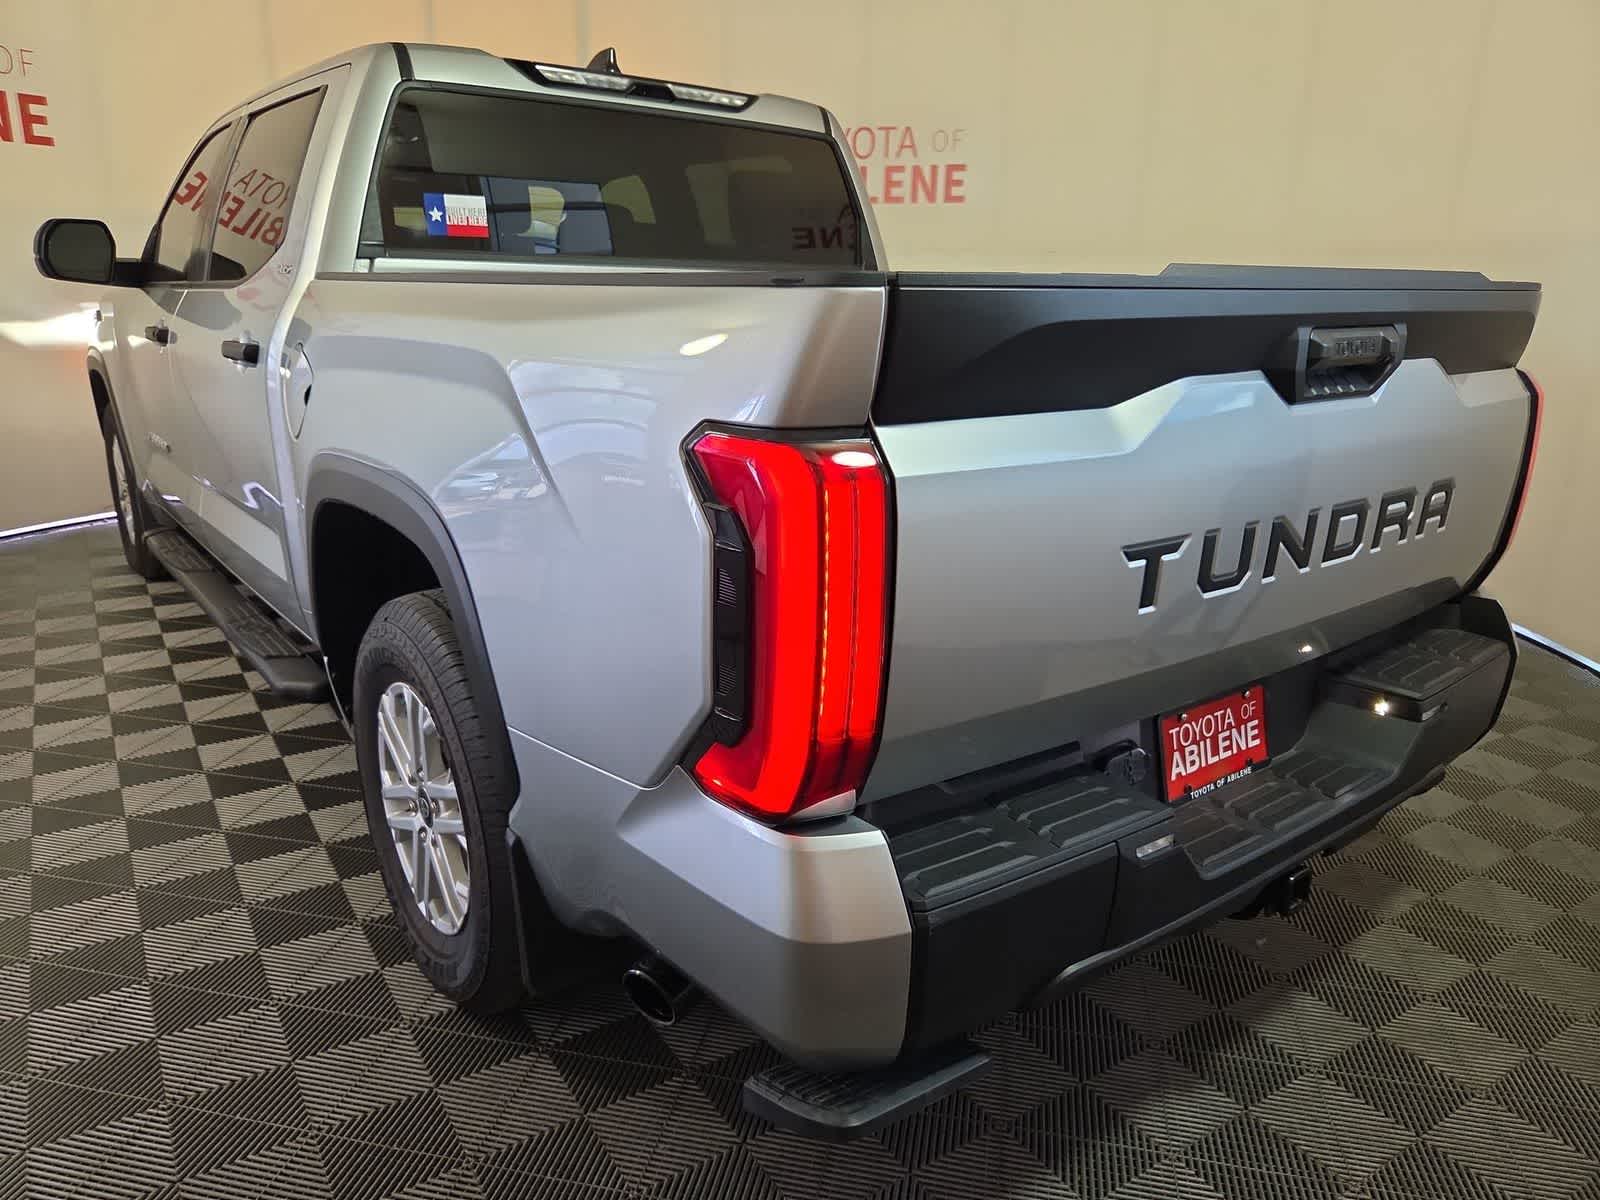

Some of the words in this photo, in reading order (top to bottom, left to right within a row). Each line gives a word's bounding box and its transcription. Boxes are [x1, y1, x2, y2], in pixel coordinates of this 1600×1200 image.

[932, 129, 967, 152] OF
[1120, 477, 1457, 615] TUNDRA
[1168, 707, 1236, 751] TOYOTA
[1240, 700, 1257, 720] OF
[1170, 719, 1261, 782] ABILENE
[1190, 784, 1215, 800] TOYOTA
[1216, 779, 1225, 789] OF
[1227, 766, 1253, 784] ABILENE
